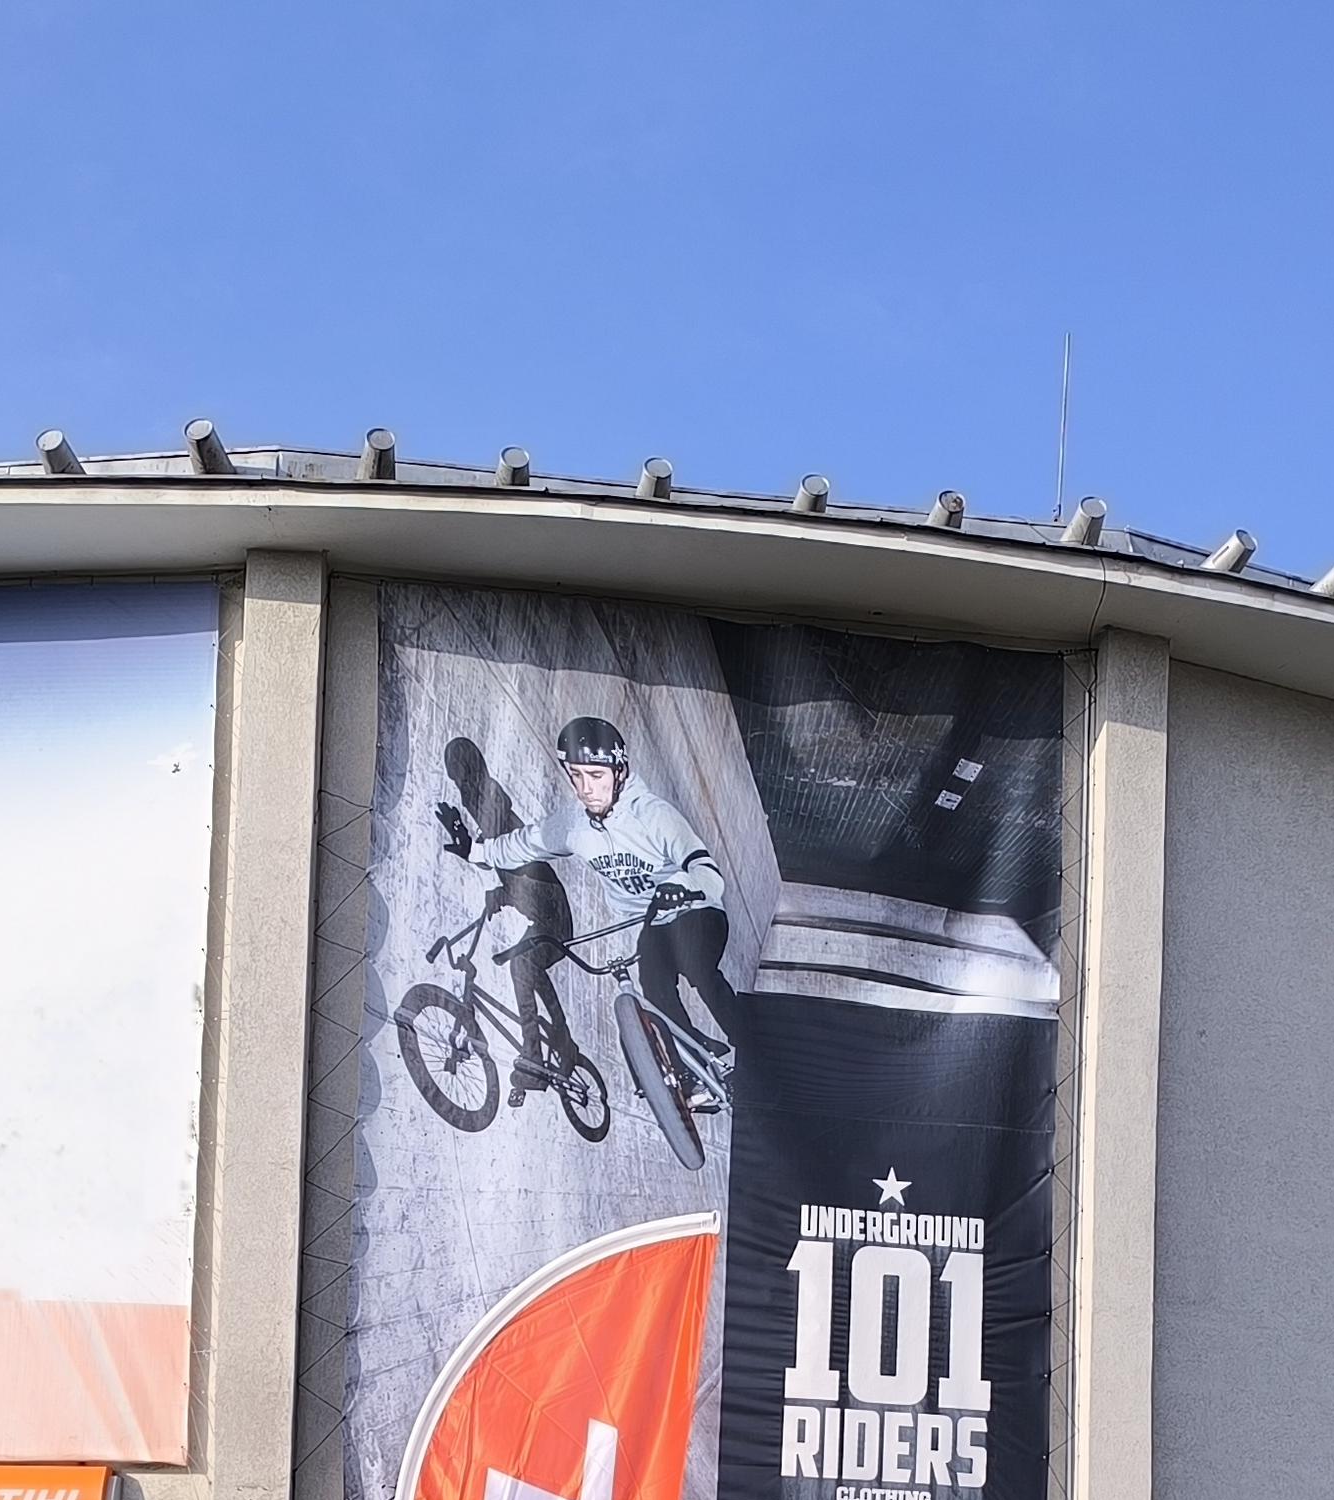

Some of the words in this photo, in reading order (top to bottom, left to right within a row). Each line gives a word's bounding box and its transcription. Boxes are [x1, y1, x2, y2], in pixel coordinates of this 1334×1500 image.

[800, 1204, 986, 1250] UNDERGROUND
[783, 1240, 992, 1412] 101
[780, 1404, 989, 1488] RIDERS
